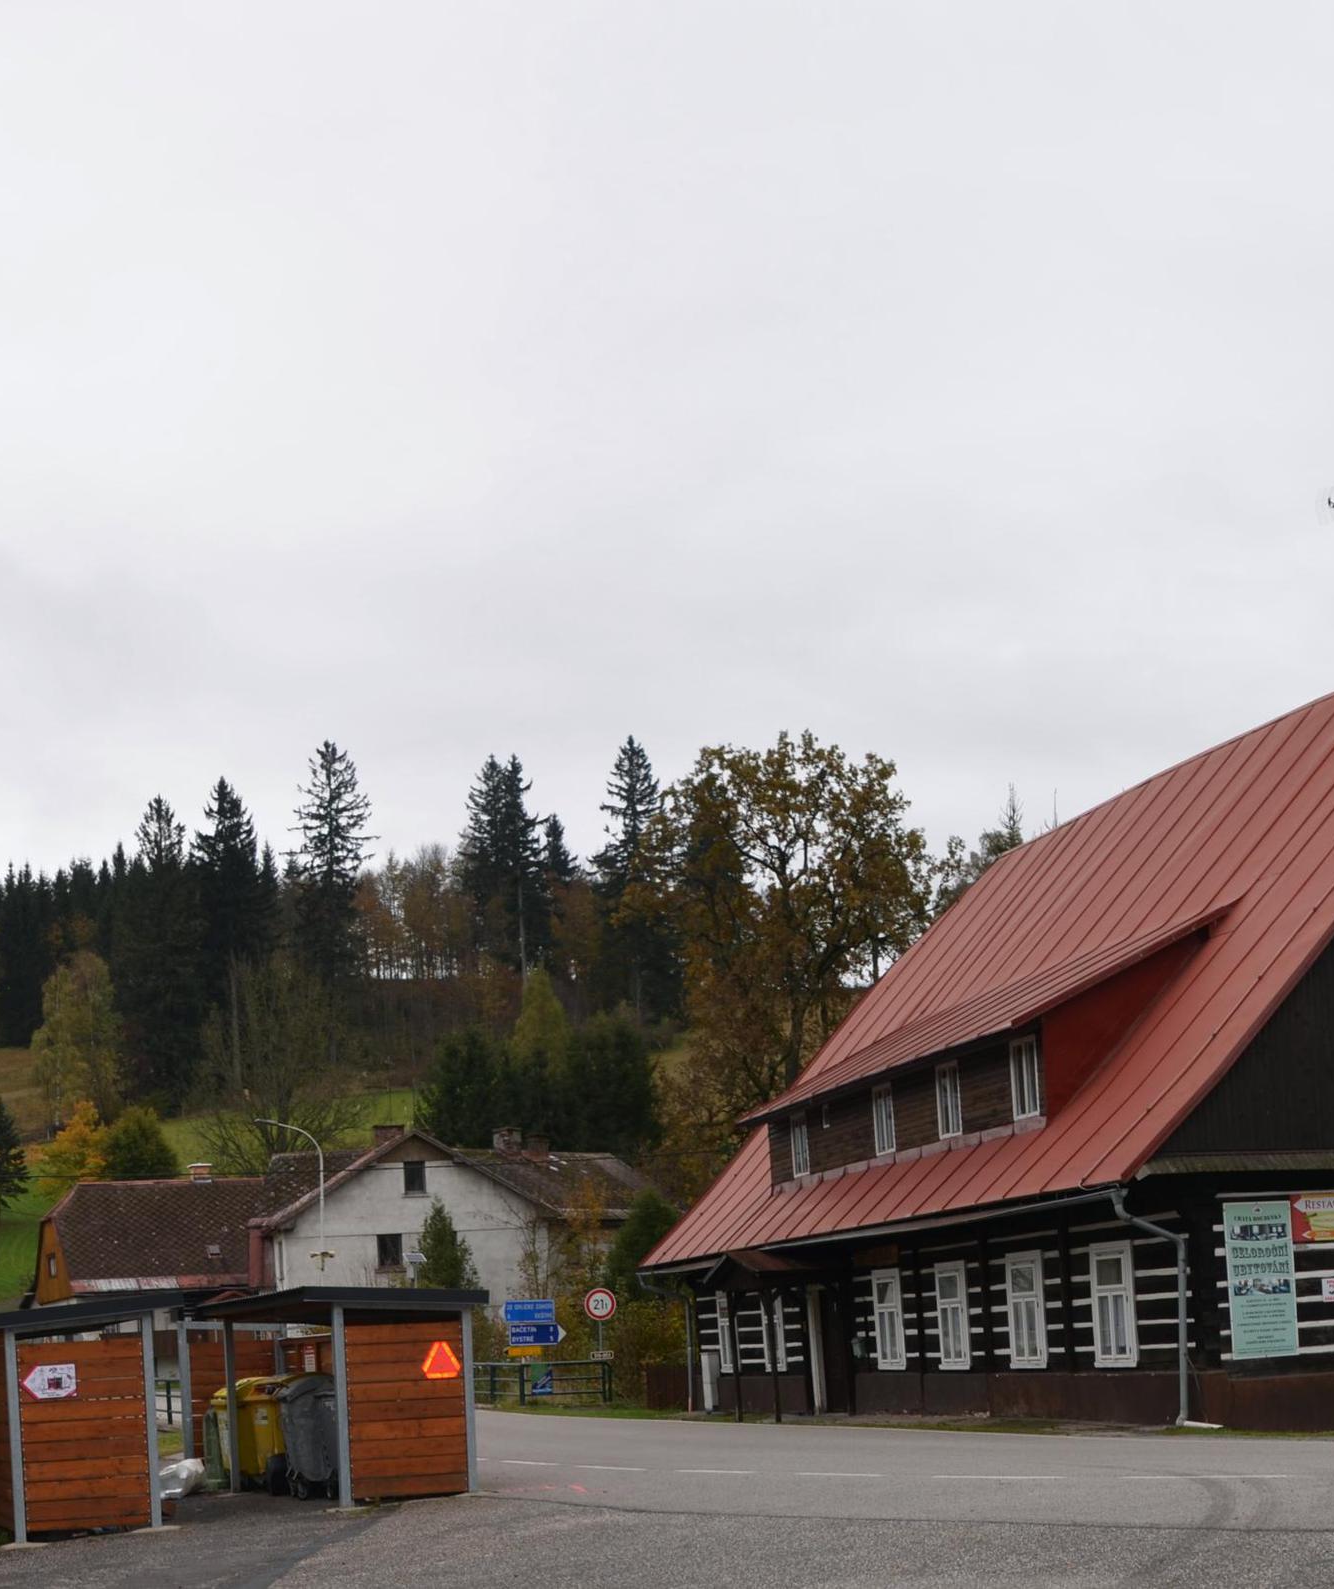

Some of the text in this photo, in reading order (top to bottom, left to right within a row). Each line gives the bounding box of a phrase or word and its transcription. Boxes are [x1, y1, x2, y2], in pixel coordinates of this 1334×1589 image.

[1232, 1242, 1289, 1259] CELOROČNÍ
[1233, 1260, 1291, 1277] UBYTOVÁNÍ
[511, 1335, 535, 1343] BYSTRÉ
